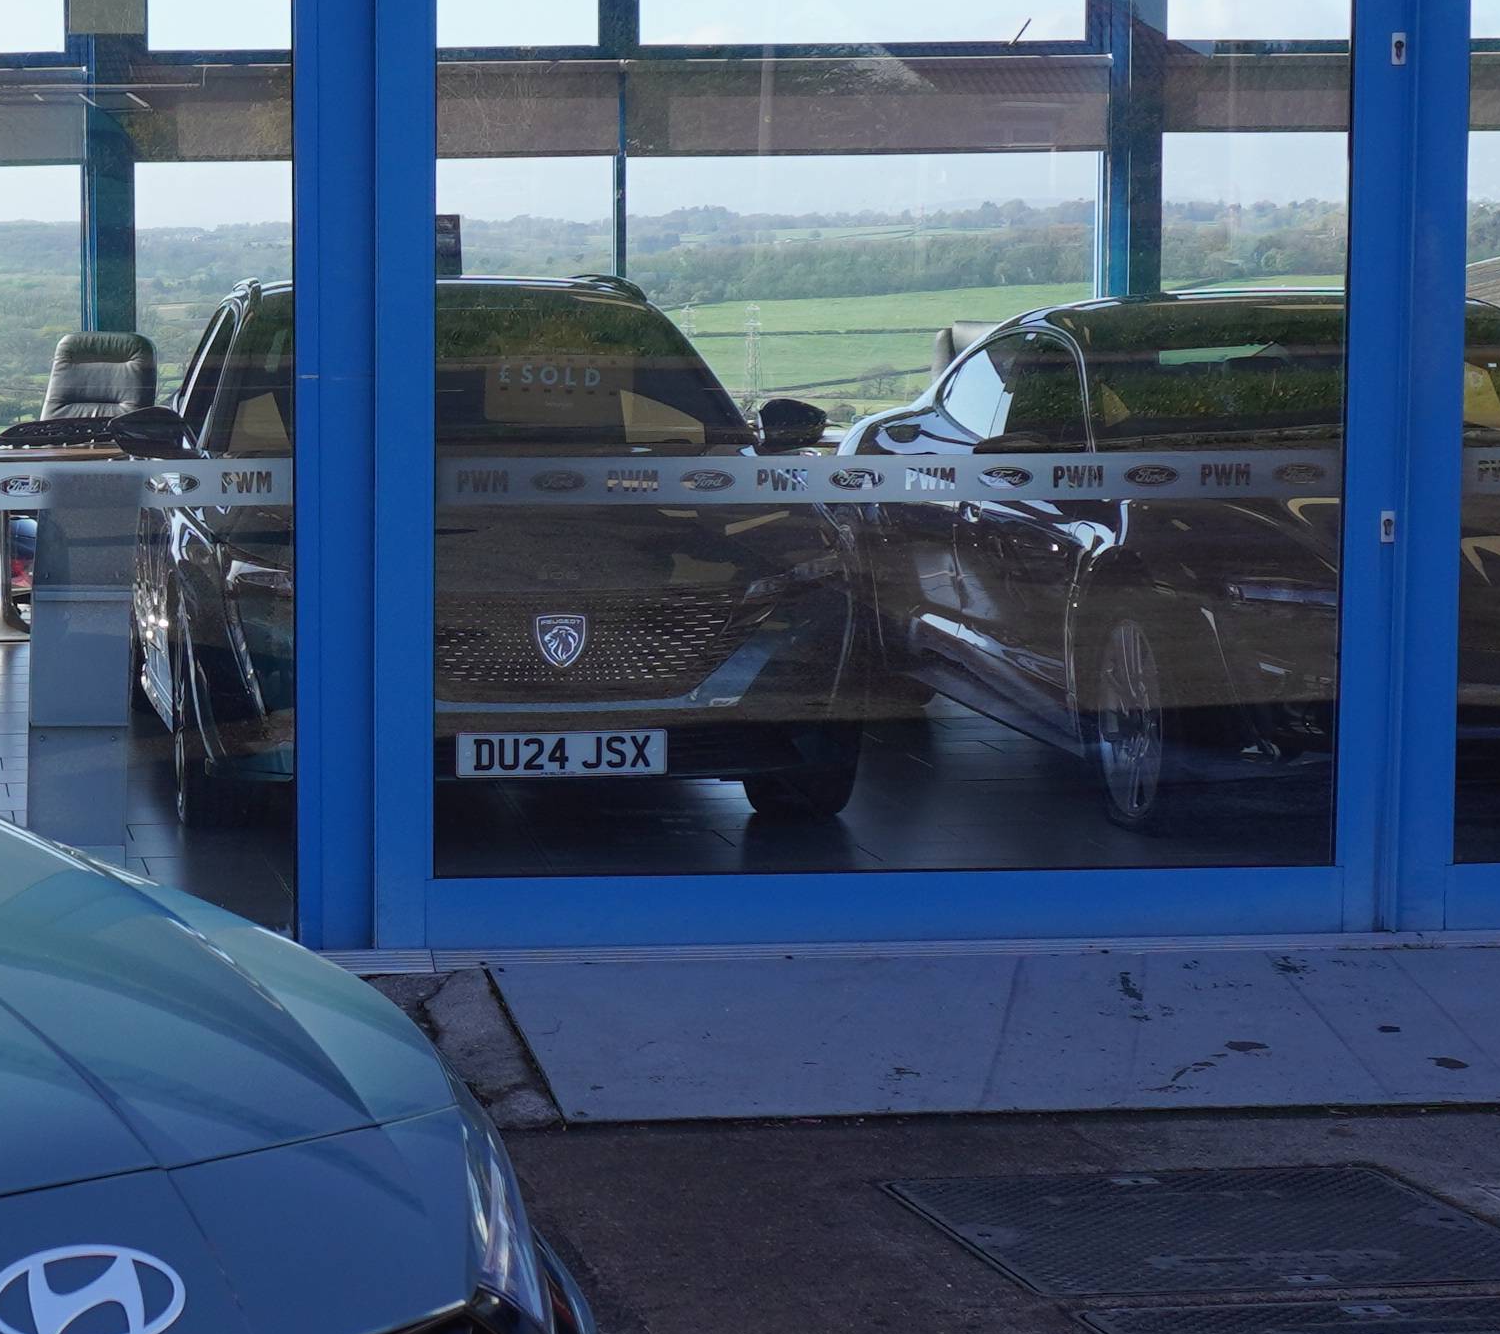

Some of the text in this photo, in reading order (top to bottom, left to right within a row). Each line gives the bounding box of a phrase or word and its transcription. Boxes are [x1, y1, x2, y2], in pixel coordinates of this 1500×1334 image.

[521, 364, 601, 387] SOLD
[221, 471, 272, 494] PWM
[456, 470, 509, 493] PWM
[607, 470, 659, 493] PWM
[905, 468, 956, 490] PWM
[1053, 465, 1104, 488] PWM
[1201, 464, 1250, 487] PWM
[540, 618, 582, 626] PEUGEOT
[473, 734, 652, 771] DU24 JSX
